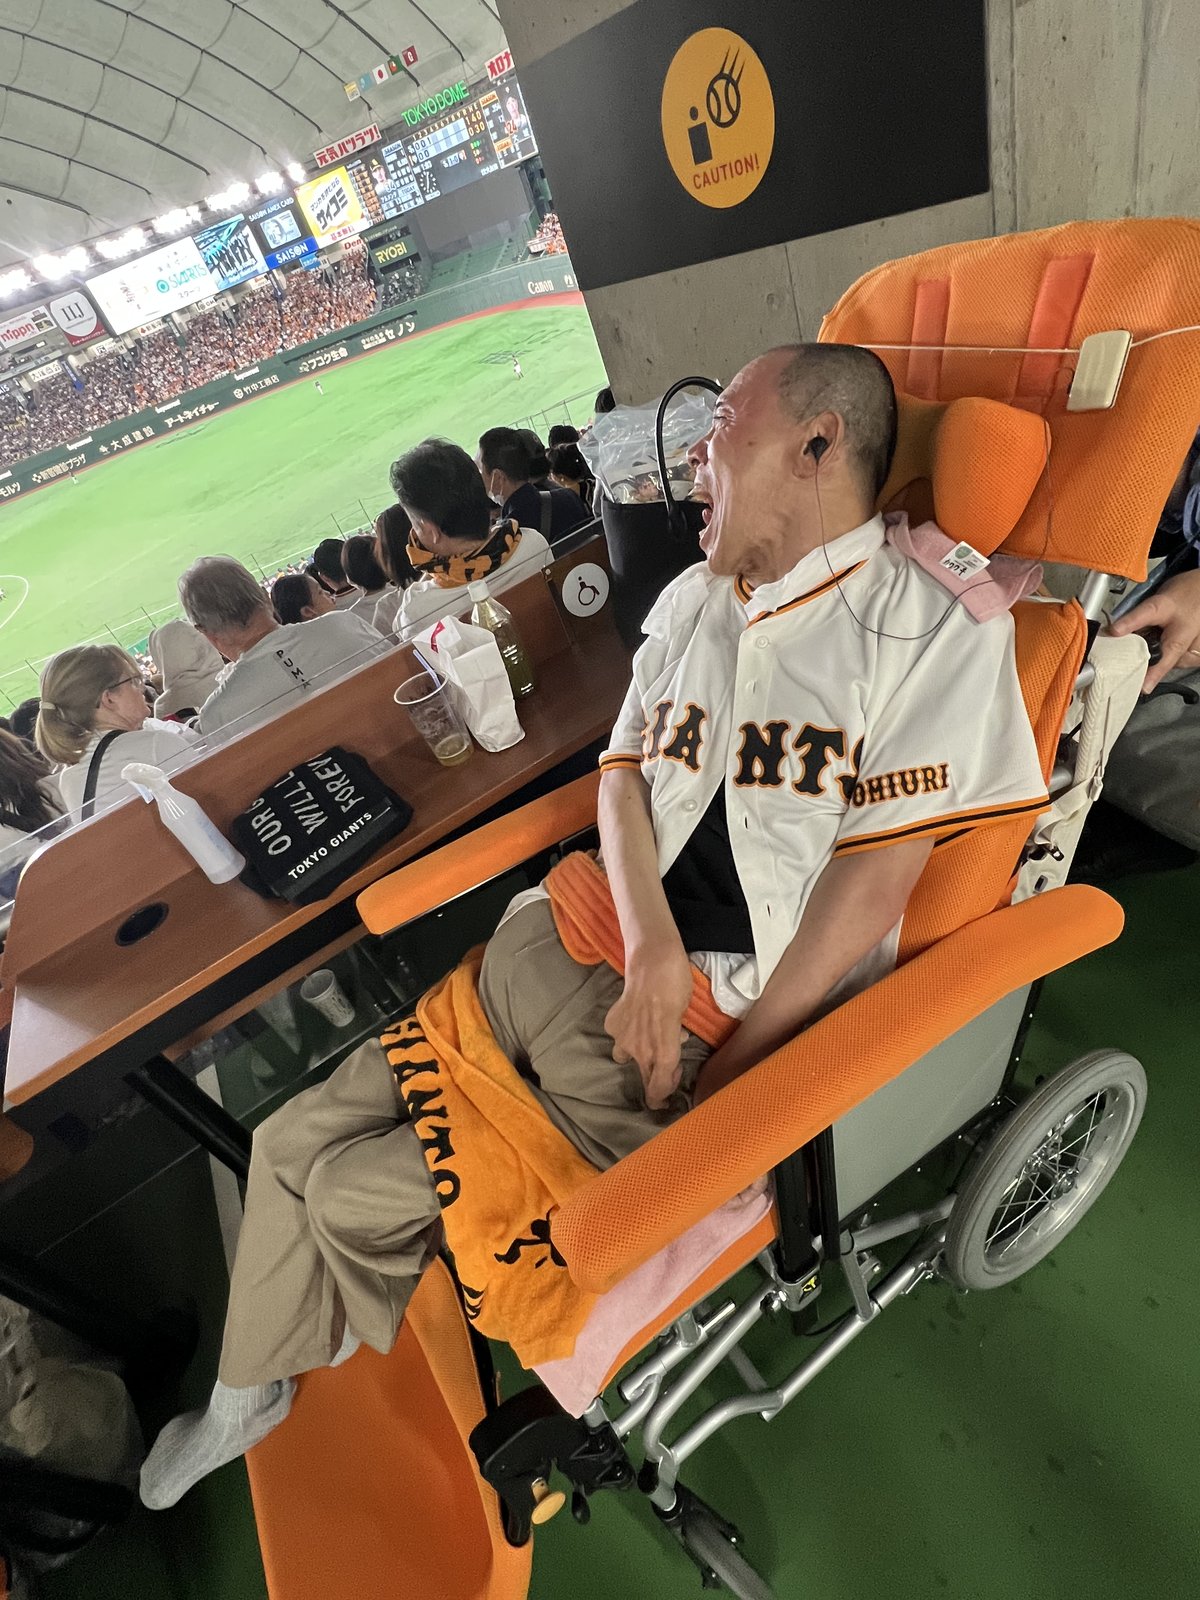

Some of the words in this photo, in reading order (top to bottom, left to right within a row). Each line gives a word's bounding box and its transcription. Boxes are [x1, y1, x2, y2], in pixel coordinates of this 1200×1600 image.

[401, 98, 438, 128] TOKYO
[434, 80, 470, 110] DOME
[315, 124, 381, 166] 元気ハツラツ!
[693, 152, 760, 190] CAUTION!
[280, 197, 294, 208] CARD
[276, 243, 308, 263] SAISON
[376, 242, 408, 264] RYOBI
[528, 280, 554, 294] Canon
[61, 302, 85, 321] IIJ
[0, 322, 35, 342] nippn
[385, 322, 415, 340] セノン
[276, 649, 312, 690] PUMA
[284, 781, 328, 835] WILL
[251, 807, 292, 856] OUR
[287, 847, 328, 880] TOKYO
[329, 812, 373, 848] GIANTS
